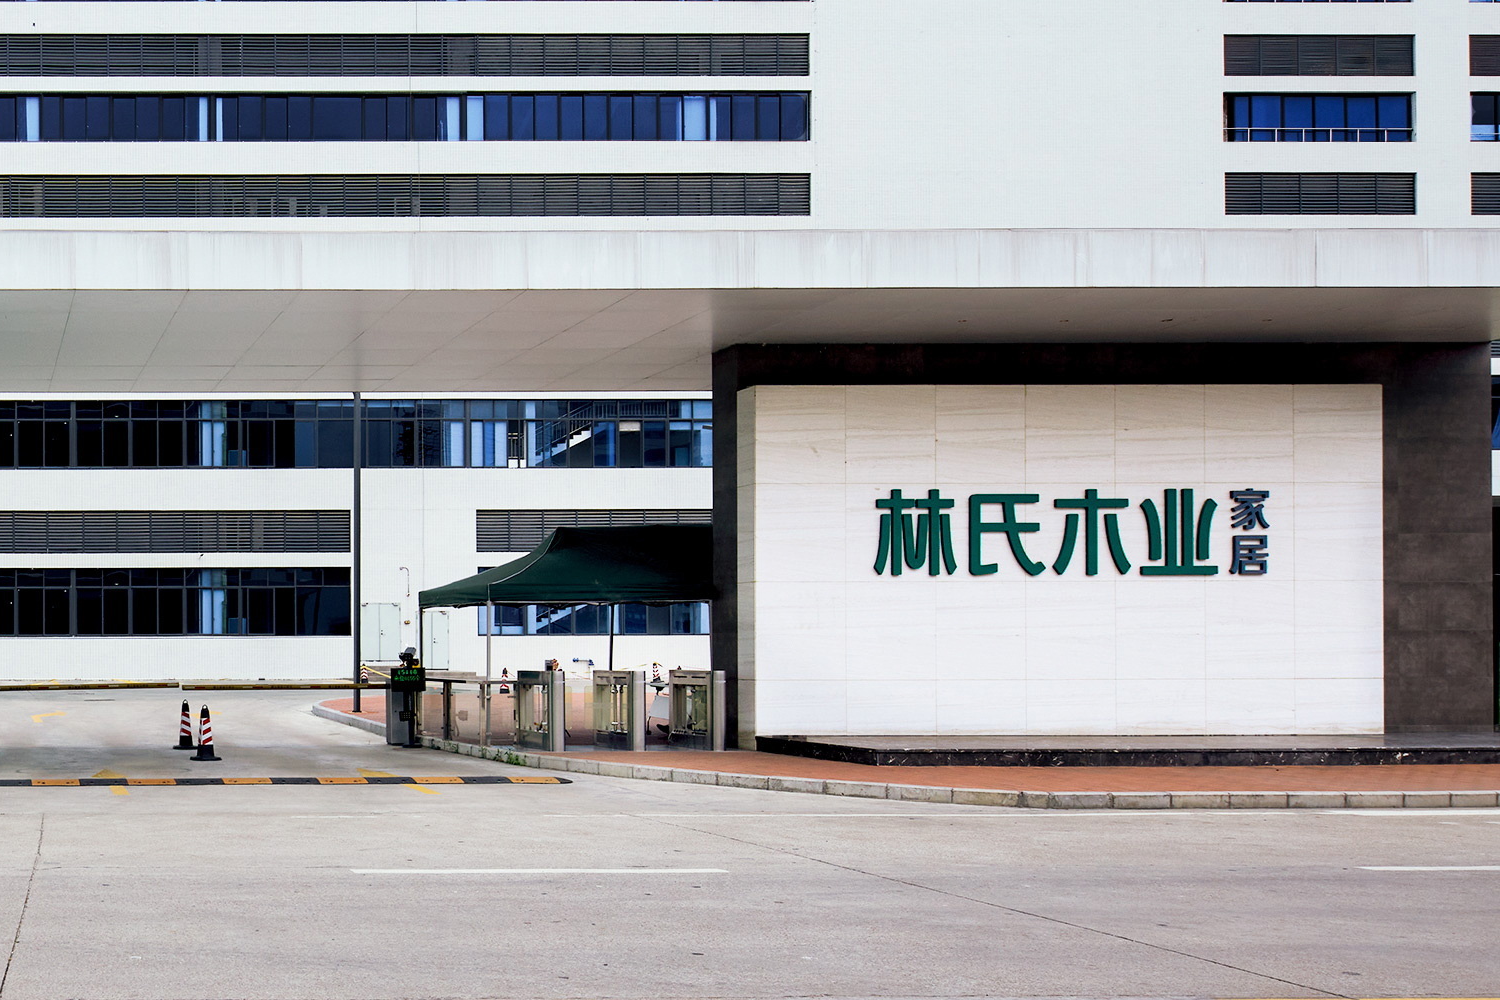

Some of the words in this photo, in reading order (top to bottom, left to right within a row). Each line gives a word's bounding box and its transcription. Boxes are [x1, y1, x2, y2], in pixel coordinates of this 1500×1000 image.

[873, 489, 1219, 577] 林氏木业
[1229, 488, 1270, 577] 家居
